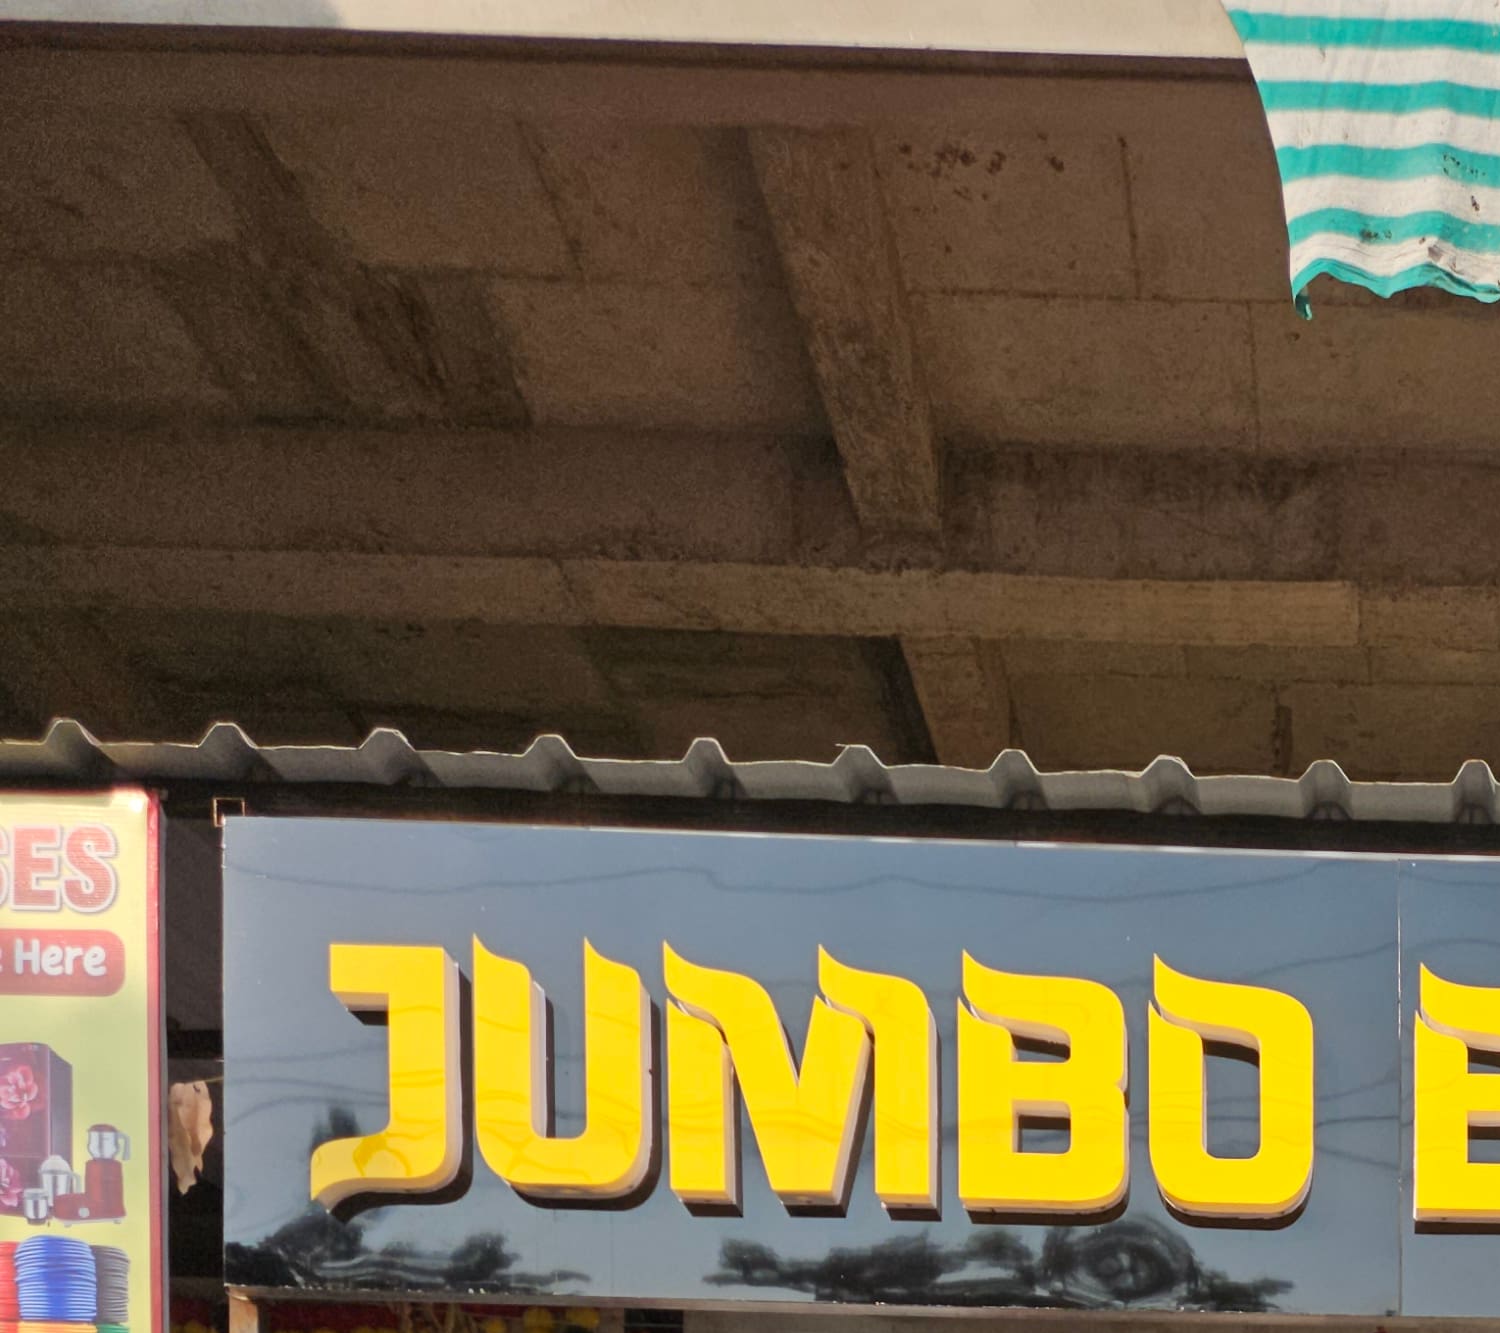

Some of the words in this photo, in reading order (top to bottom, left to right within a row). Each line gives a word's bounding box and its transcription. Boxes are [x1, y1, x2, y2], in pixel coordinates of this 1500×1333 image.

[0, 824, 118, 914] ES
[14, 938, 107, 976] Here
[309, 932, 1315, 1221] JUMBO
